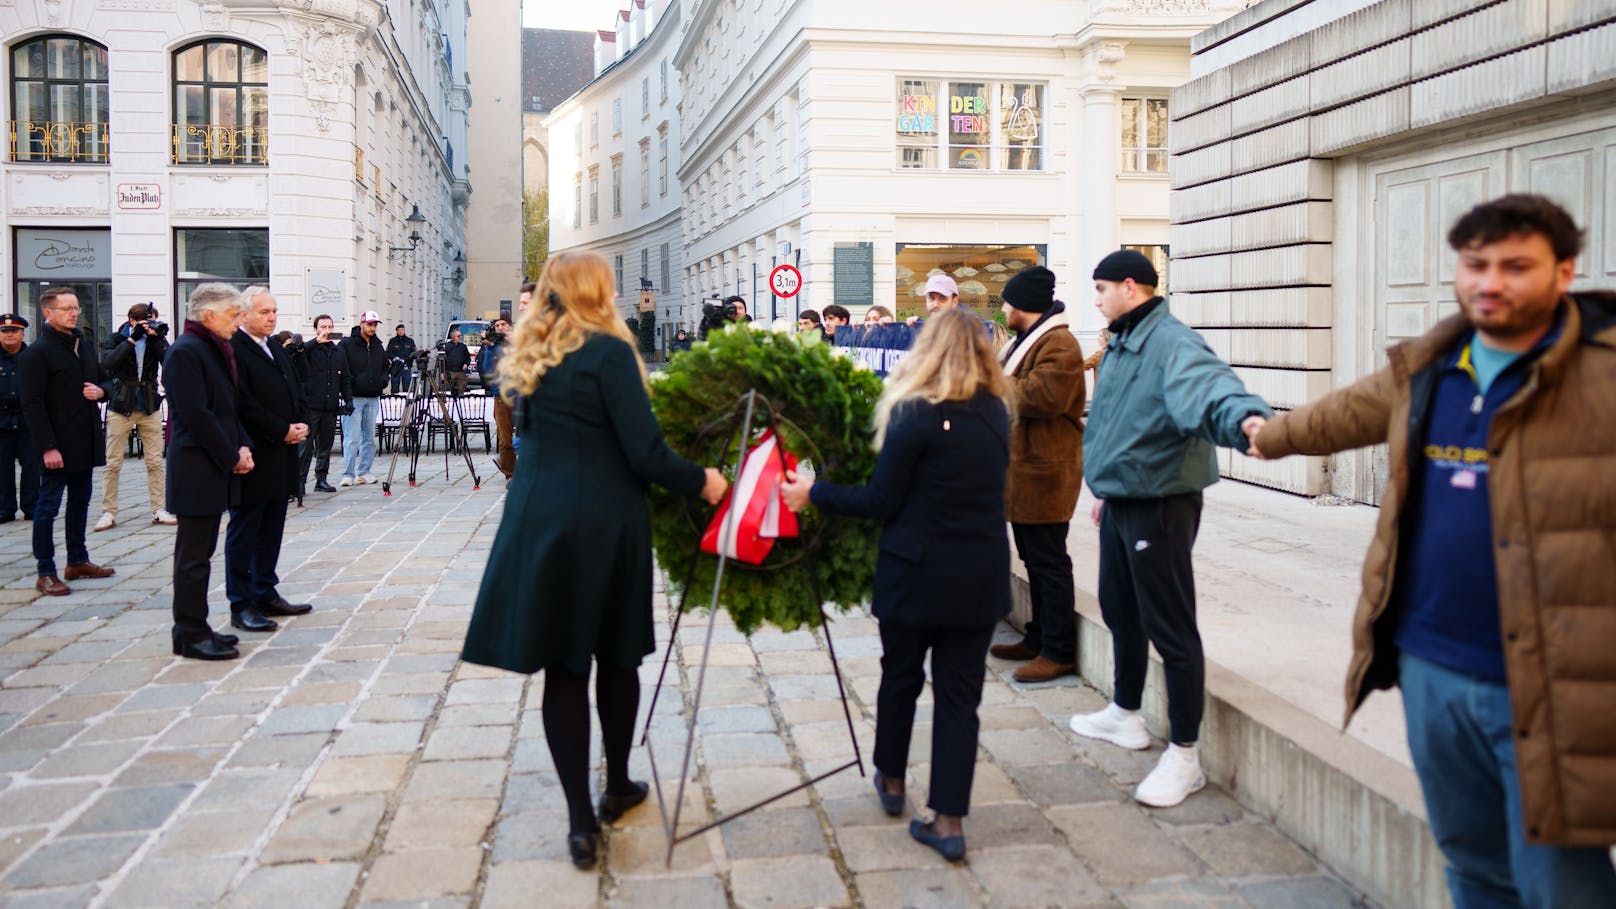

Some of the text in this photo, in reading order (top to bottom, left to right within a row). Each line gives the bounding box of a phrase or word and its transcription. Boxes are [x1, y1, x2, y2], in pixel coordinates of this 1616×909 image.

[903, 95, 985, 113] KIN DER
[899, 115, 984, 133] GAR TEN
[776, 274, 796, 288] 3,1m
